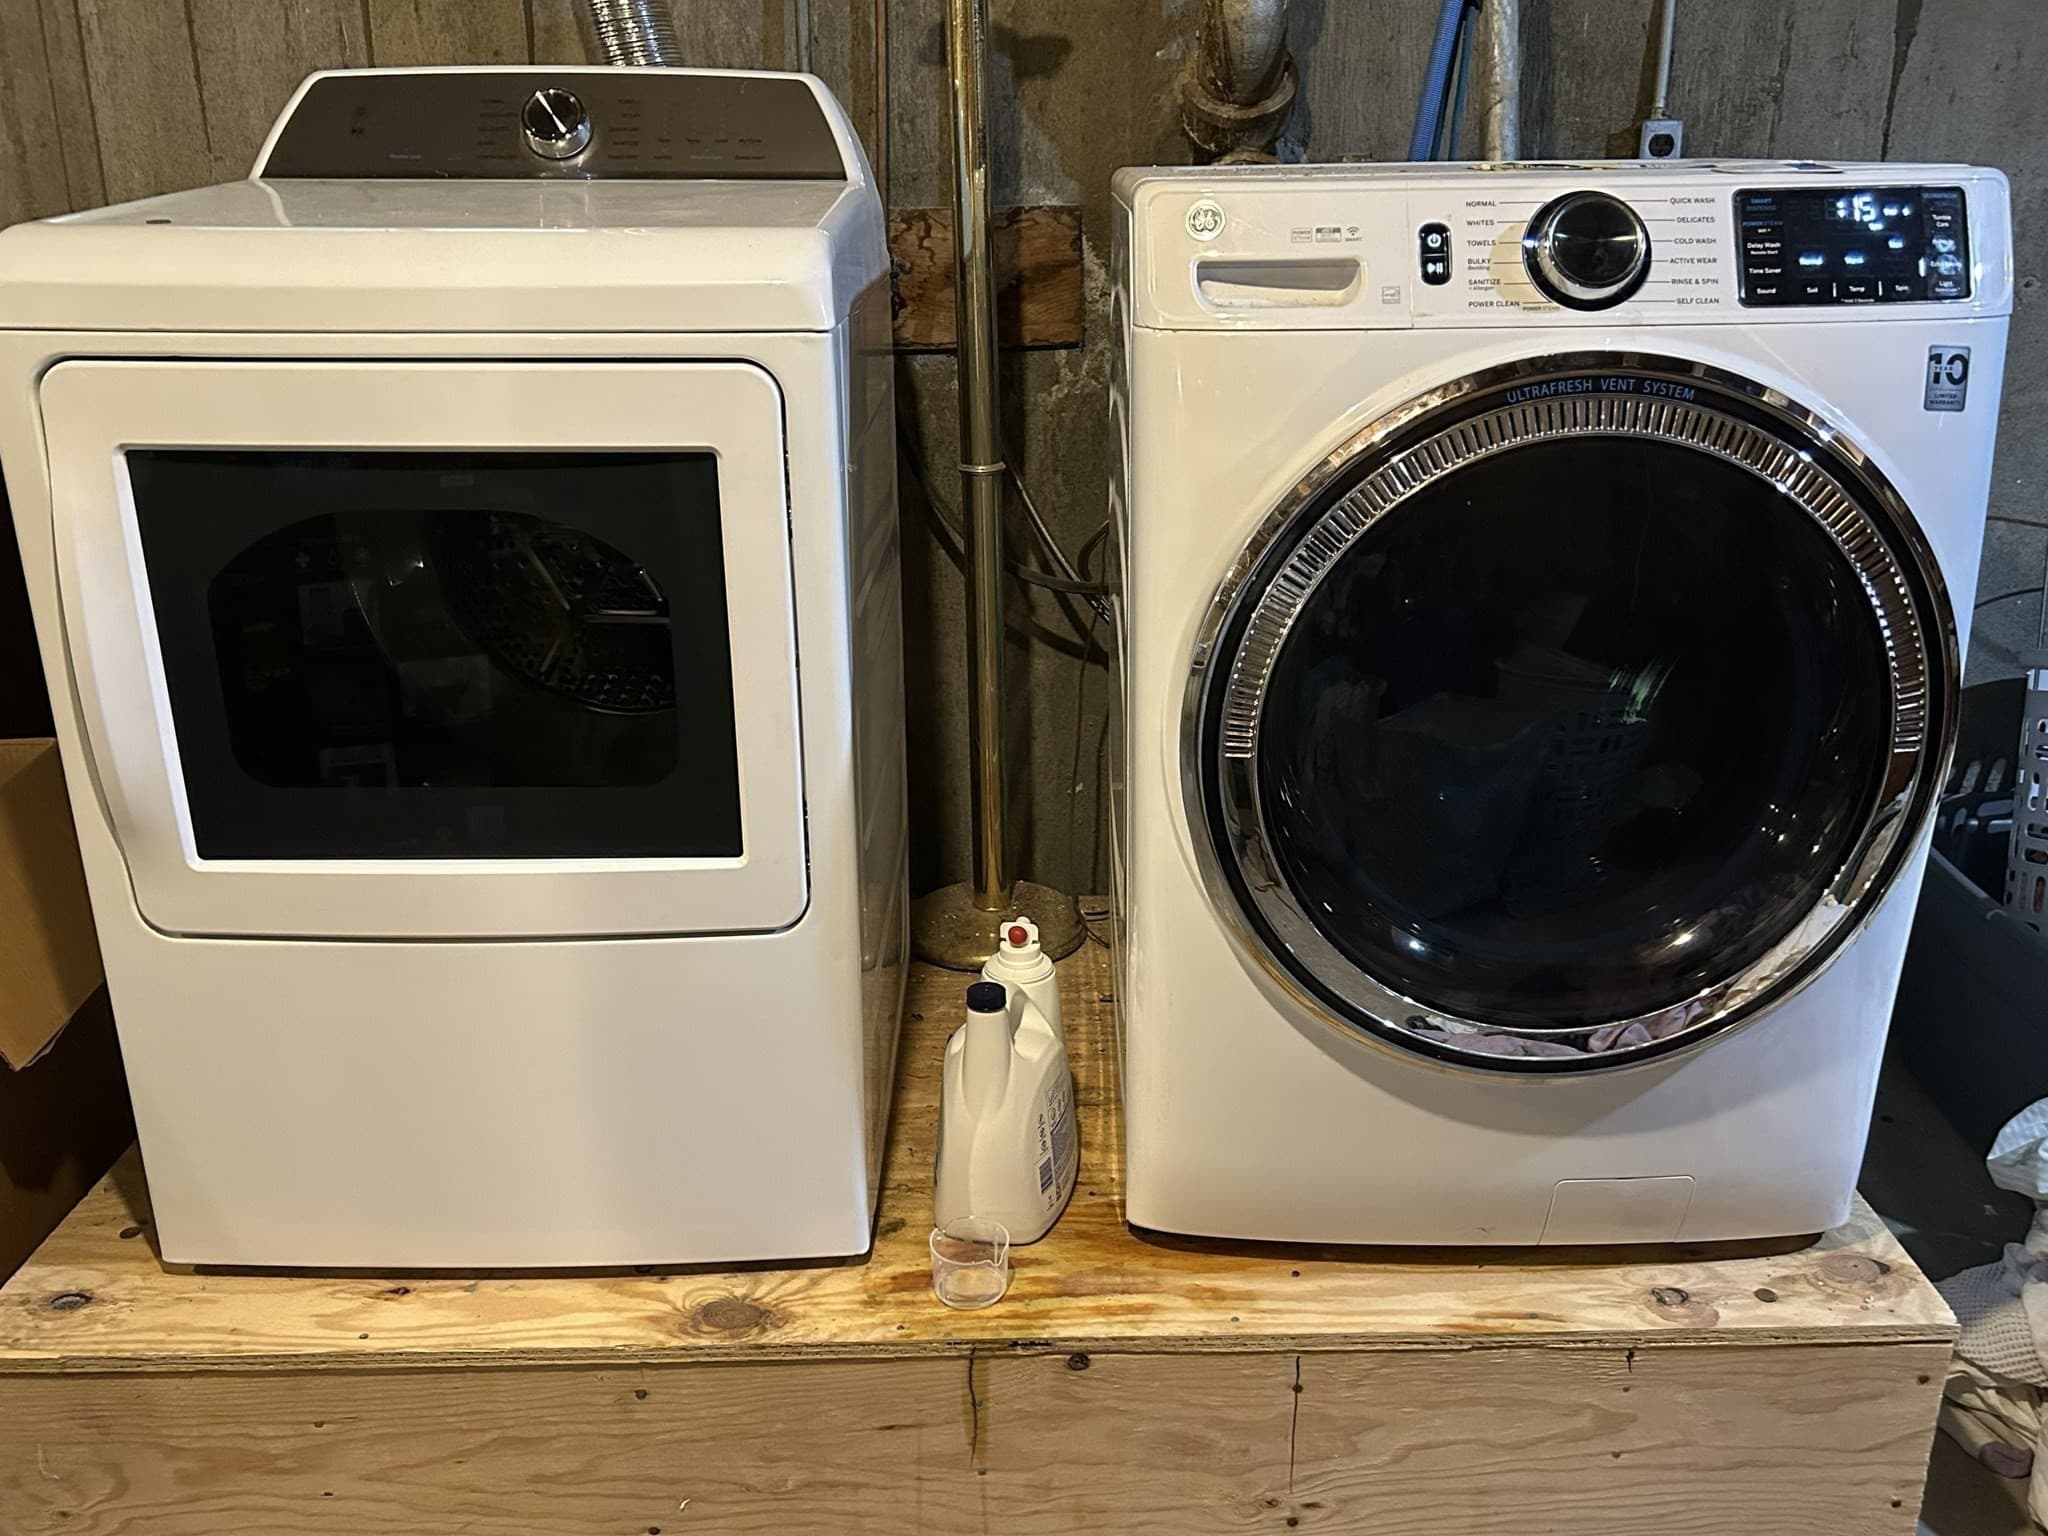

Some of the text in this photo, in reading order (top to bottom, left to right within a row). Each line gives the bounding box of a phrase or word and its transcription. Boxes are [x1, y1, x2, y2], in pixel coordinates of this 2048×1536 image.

[1848, 285, 1865, 293] Temp
[1929, 352, 1969, 386] 10
[1506, 378, 1696, 404] ULTRAFRESH VENT SYSTEM
